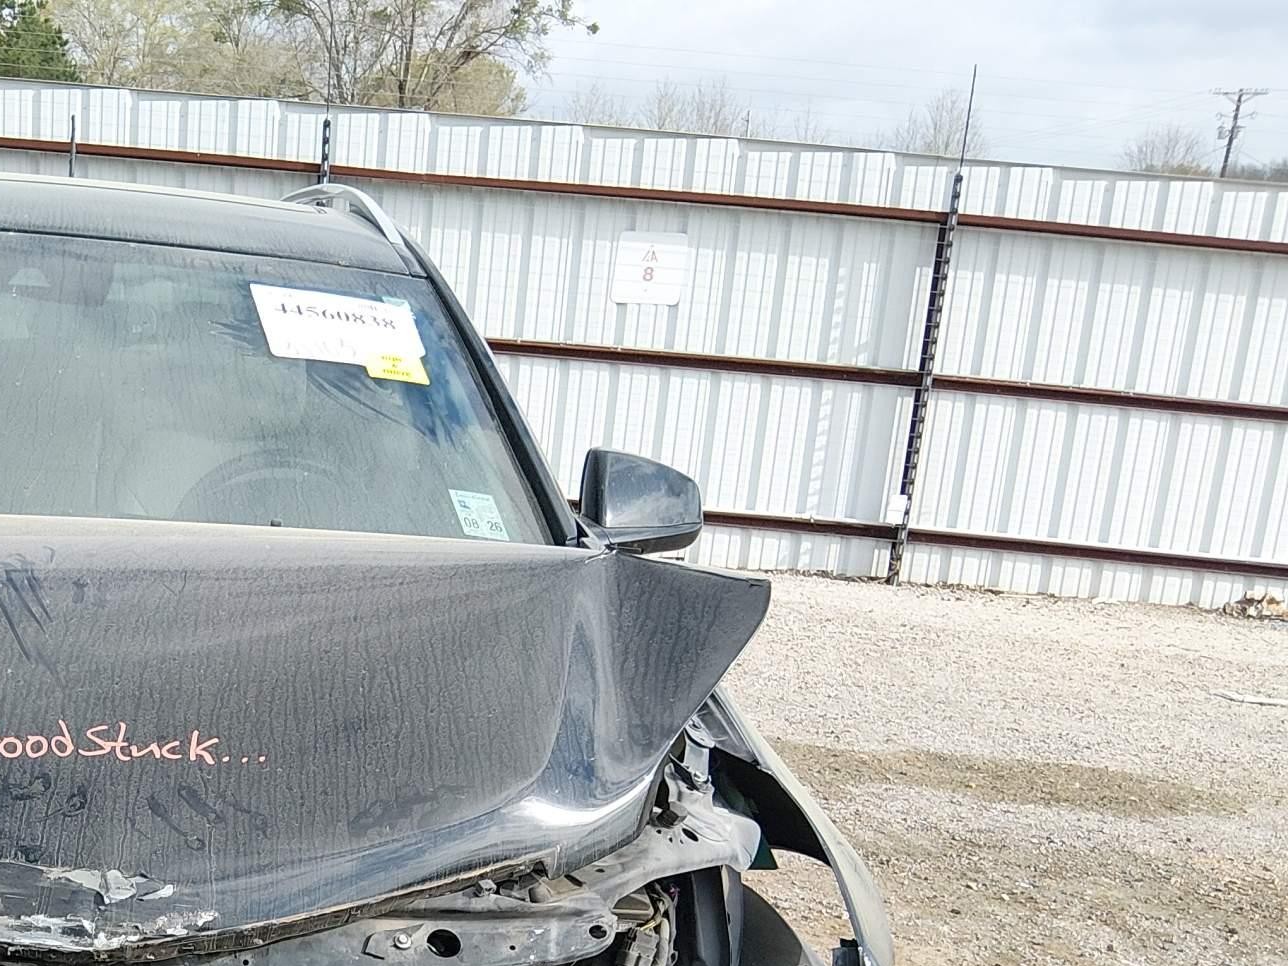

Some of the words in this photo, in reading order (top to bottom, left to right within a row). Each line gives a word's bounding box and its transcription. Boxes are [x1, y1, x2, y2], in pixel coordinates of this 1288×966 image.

[642, 266, 654, 282] 8
[463, 516, 480, 529] 08
[486, 520, 504, 533] 26
